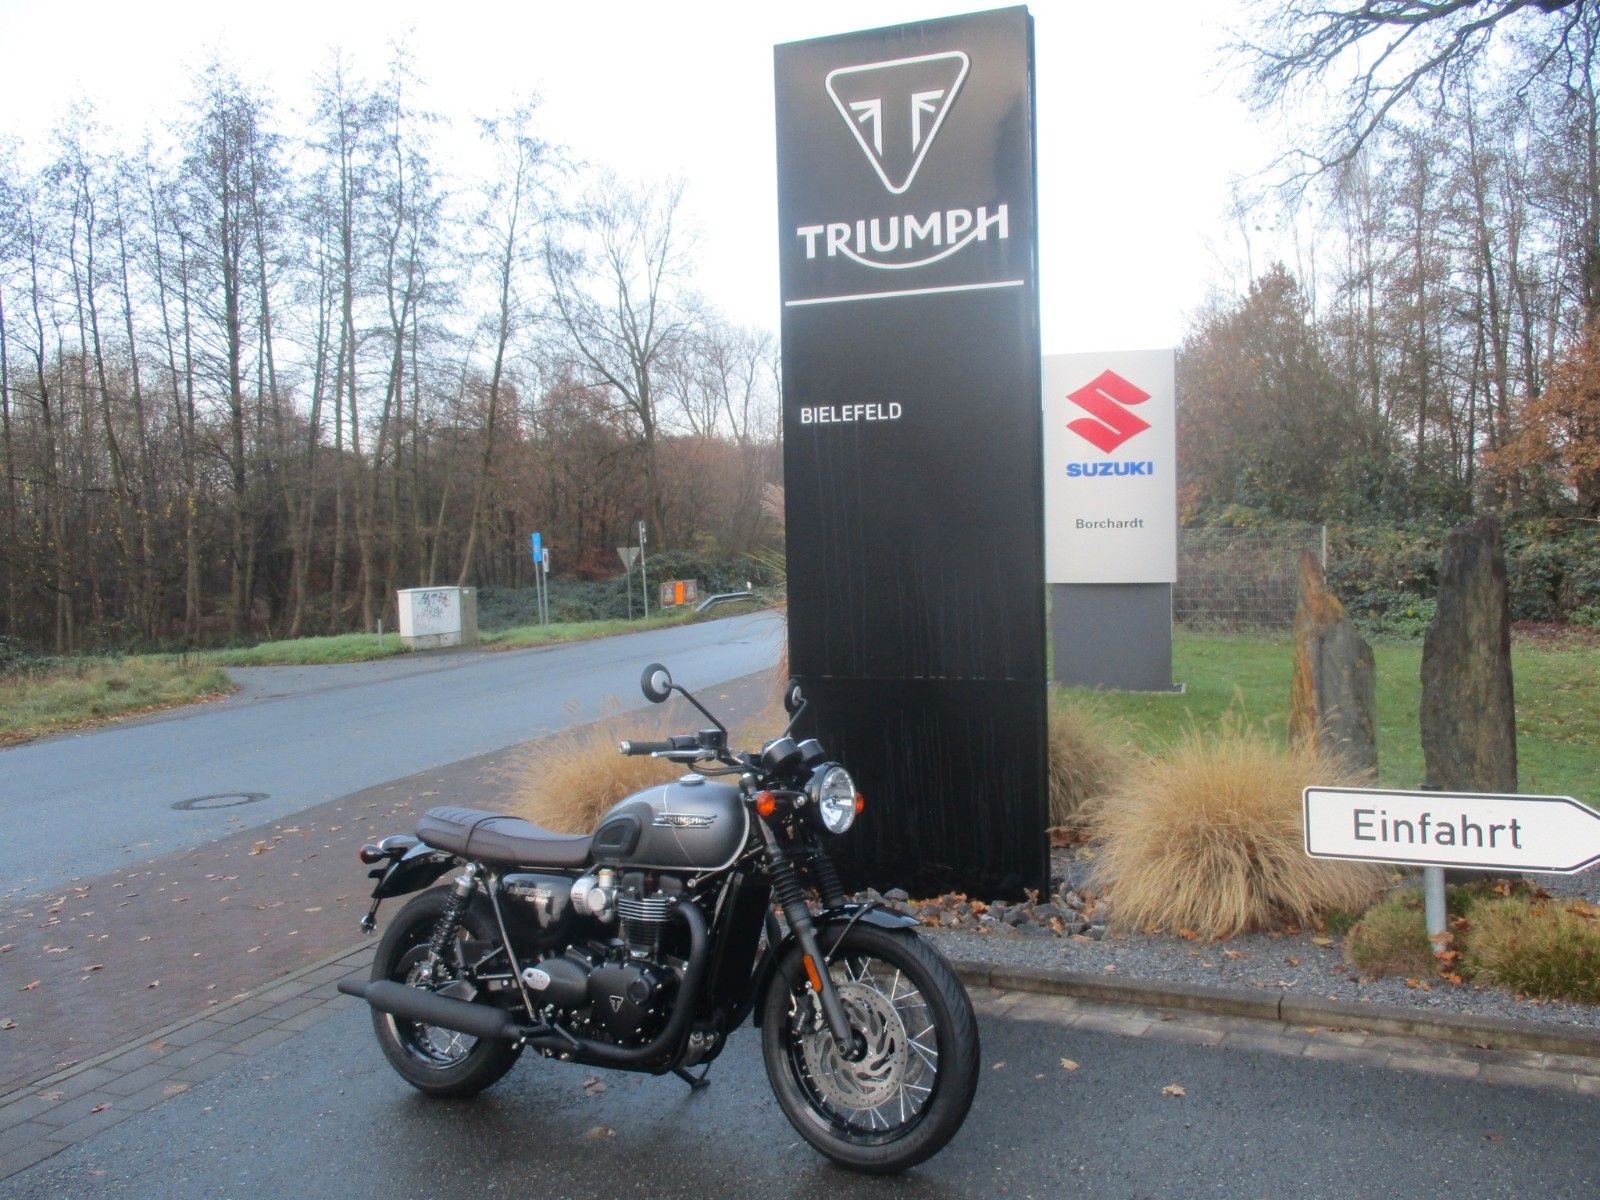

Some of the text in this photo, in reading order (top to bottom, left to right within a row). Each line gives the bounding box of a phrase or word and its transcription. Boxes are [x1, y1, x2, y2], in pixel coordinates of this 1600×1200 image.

[797, 204, 1009, 269] TRIUMPH
[801, 402, 902, 424] BIELEFELD
[1066, 461, 1153, 477] SUZUKI
[1076, 518, 1144, 529] Borchardt
[1353, 808, 1522, 849] Einfahrt
